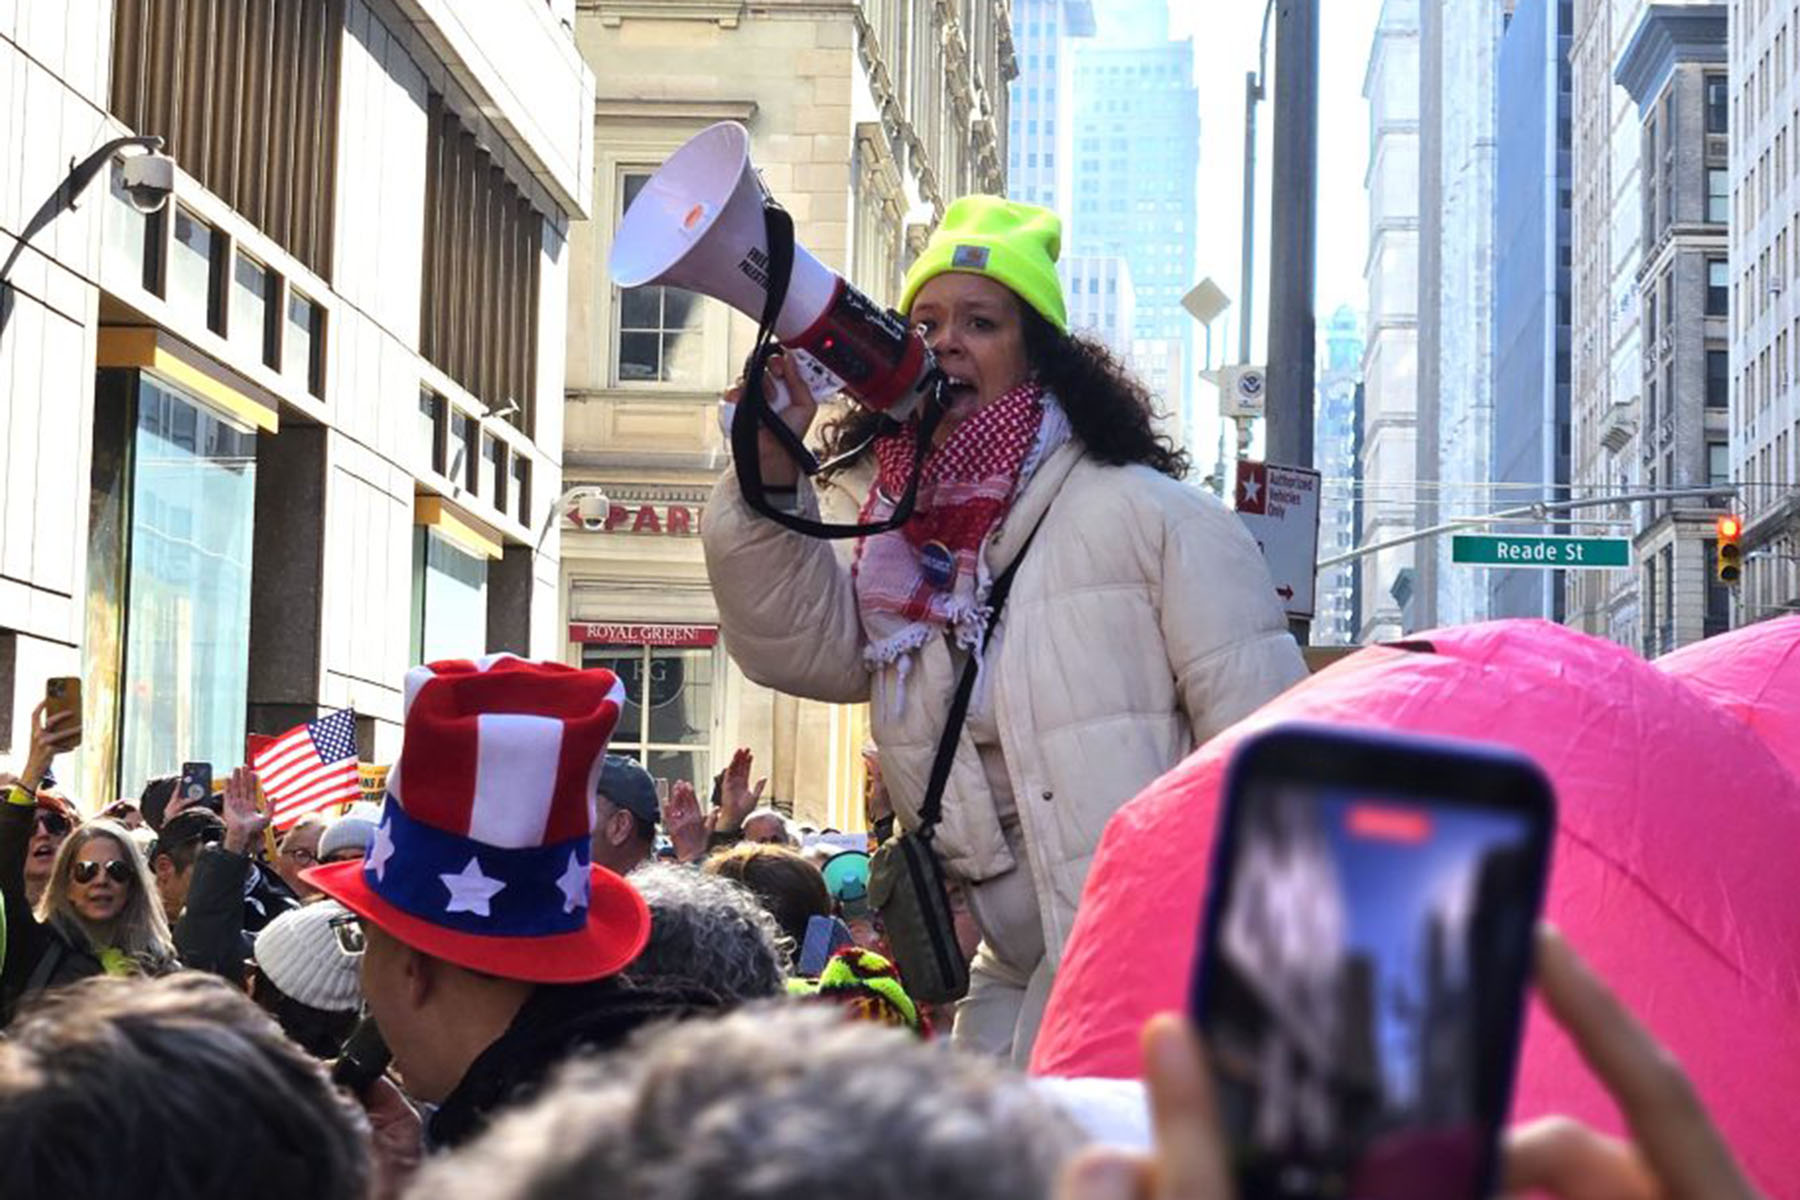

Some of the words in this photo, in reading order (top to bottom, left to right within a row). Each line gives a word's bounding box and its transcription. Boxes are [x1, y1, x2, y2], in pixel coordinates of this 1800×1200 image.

[746, 246, 769, 269] FREE
[738, 259, 775, 290] PALESTIN
[1270, 472, 1313, 491] Authorized
[1269, 487, 1301, 505] Vehicles
[605, 504, 702, 534] PAR
[1268, 502, 1286, 521] Only
[1497, 542, 1557, 561] Reade
[1565, 544, 1584, 561] St
[587, 624, 638, 639] ROYAL
